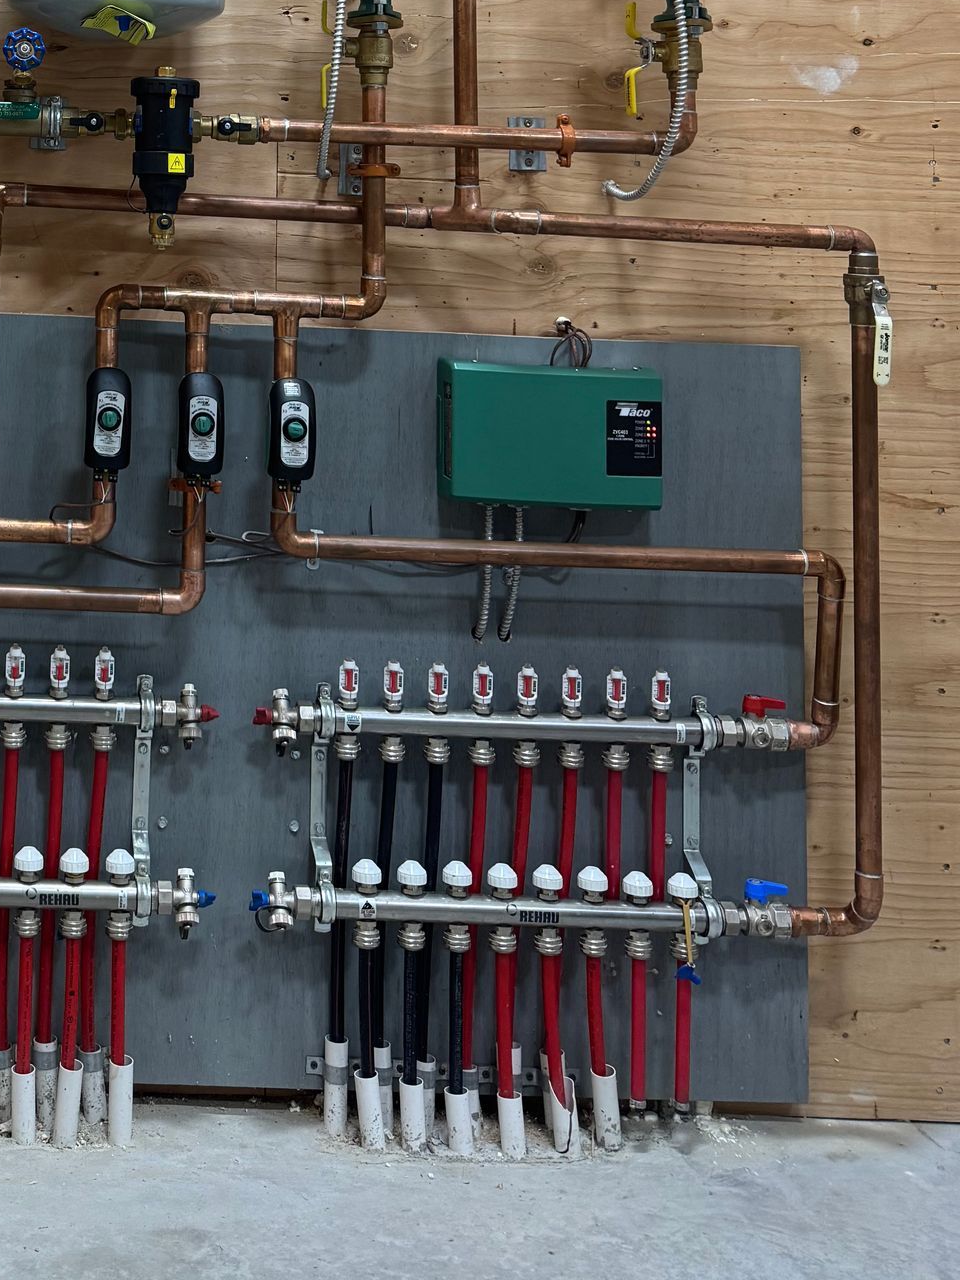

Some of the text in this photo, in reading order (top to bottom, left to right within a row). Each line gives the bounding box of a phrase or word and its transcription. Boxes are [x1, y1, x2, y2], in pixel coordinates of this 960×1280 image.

[615, 402, 651, 417] Taco
[39, 893, 80, 906] REHAU
[519, 910, 560, 924] REHAU
